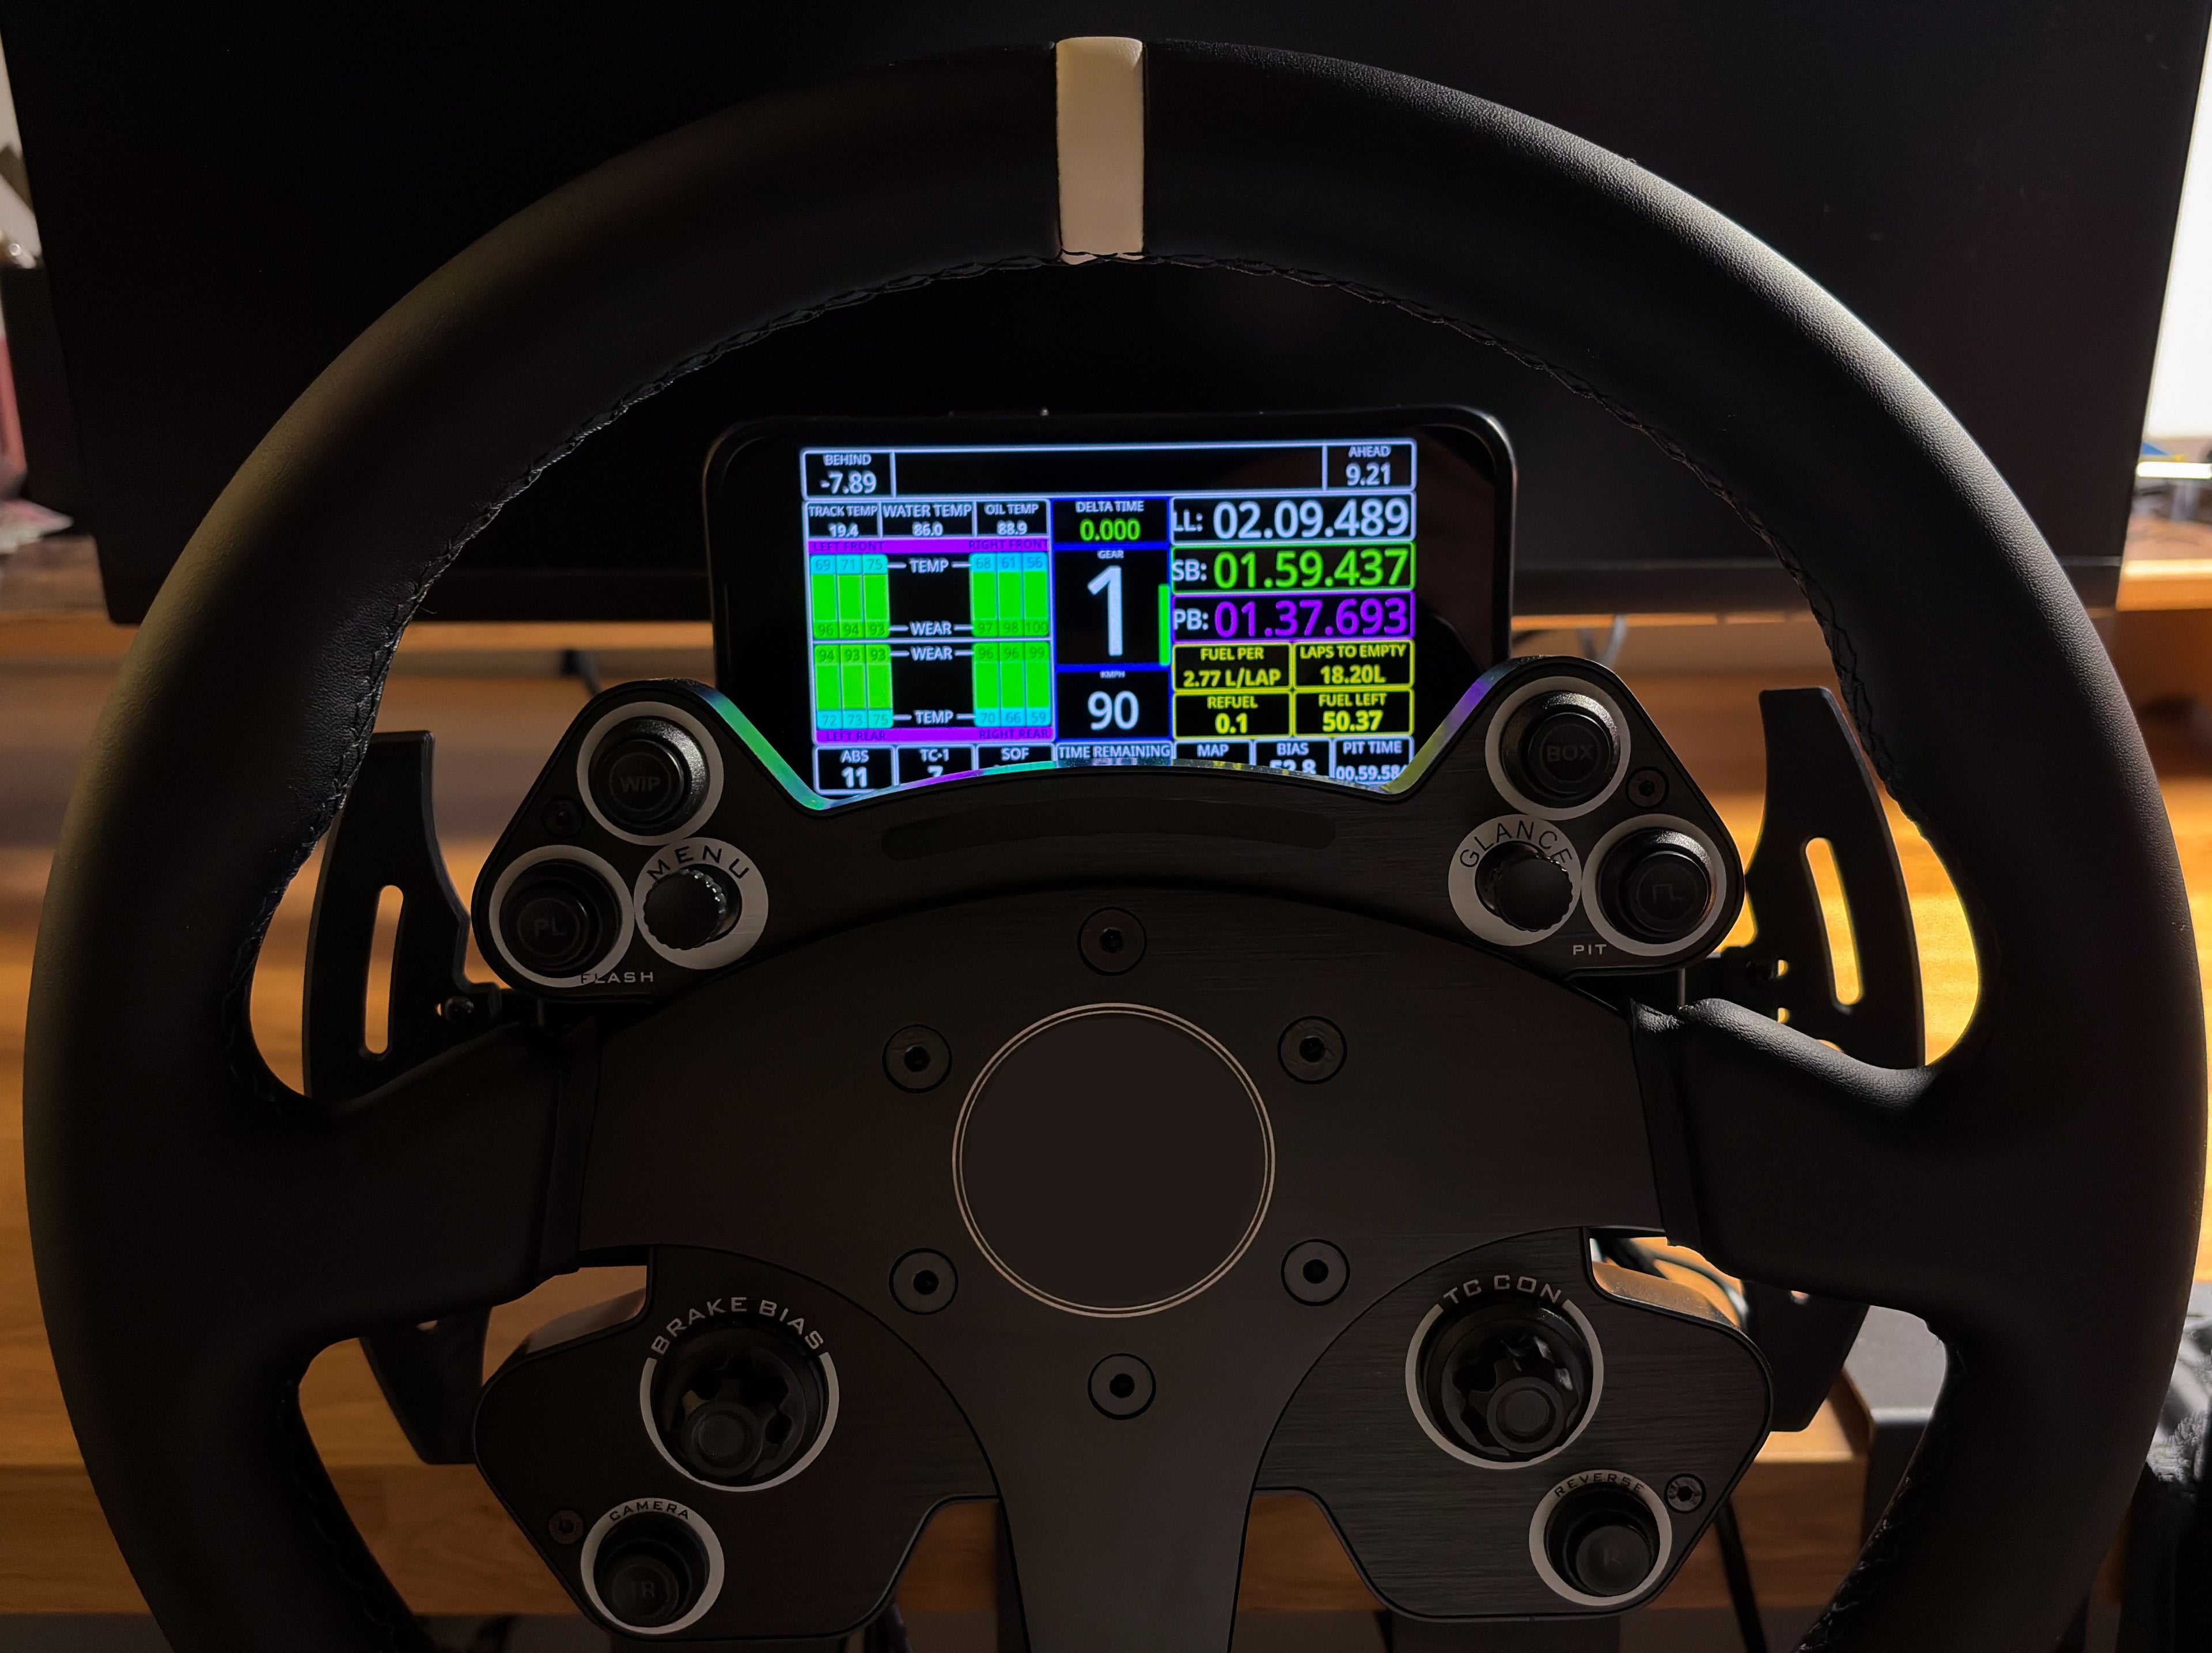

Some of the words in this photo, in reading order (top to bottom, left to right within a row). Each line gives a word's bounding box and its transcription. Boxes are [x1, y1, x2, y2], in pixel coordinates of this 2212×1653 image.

[1349, 445, 1392, 458] AHEAD
[823, 454, 871, 467] BEHIND
[1346, 463, 1391, 486] 9.21
[820, 471, 876, 494] -7.89
[809, 505, 844, 517] TRACK
[847, 505, 877, 516] TEMP
[882, 505, 930, 517] WATER
[934, 504, 972, 516] TEMP
[984, 504, 1005, 515] OIL
[1007, 504, 1039, 515] TEMP
[1075, 501, 1113, 512] DELTA
[1114, 500, 1144, 512] TIME
[1173, 509, 1203, 532] LL:
[1213, 498, 1409, 539] 02.09.489
[828, 524, 859, 538] 19.4
[912, 522, 944, 536] 86.0
[997, 520, 1028, 536] 88.9
[1080, 518, 1141, 541] 0.000
[813, 542, 839, 551] LEFT
[844, 542, 884, 551] FRONT
[969, 540, 1004, 550] RIGHT
[1009, 539, 1048, 549] FRONT
[1097, 550, 1124, 559] GEAR
[816, 558, 831, 571] 69
[841, 558, 855, 570] 71
[867, 558, 883, 570] 75
[908, 558, 949, 574] TEMP
[1002, 557, 1016, 569] 61
[1172, 559, 1207, 581] SB:
[1214, 548, 1409, 588] 01.59.437
[1087, 565, 1123, 656] 1
[1174, 608, 1209, 630] PB:
[1214, 597, 1408, 638] 01.37.693
[910, 621, 952, 636] WEAR
[910, 646, 953, 661] WEAR
[1200, 647, 1234, 661] FUEL
[1238, 646, 1264, 660] PER
[1300, 645, 1335, 659] LAPS
[1338, 645, 1356, 658] TO
[1359, 644, 1406, 658] EMPTY
[1100, 671, 1126, 679] KMPH
[1183, 670, 1221, 687] 2.77
[1225, 667, 1281, 688] L/LAP
[1320, 664, 1387, 684] 18.20L
[1207, 695, 1258, 709] REFUEL
[1319, 694, 1353, 708] FUEL
[1355, 693, 1387, 706] LEFT
[915, 710, 954, 725] TEMP
[1088, 691, 1139, 731] 90
[821, 714, 838, 726] 72
[1214, 713, 1248, 734] 0.1
[1323, 710, 1383, 732] 50.37
[827, 732, 851, 742] LEFT
[979, 729, 1014, 739] RIGHT
[1018, 728, 1048, 739] REAR
[1001, 748, 1029, 761] SOF
[1059, 747, 1090, 758] TIME
[1094, 745, 1171, 758] REMAINING
[1197, 744, 1229, 758] MAP
[1277, 743, 1309, 756] BIAS
[1343, 742, 1365, 755] PIT
[1368, 741, 1403, 754] TIME
[1547, 744, 1594, 762] BOX
[842, 749, 869, 763] ABS
[841, 766, 868, 788] 11
[1460, 819, 1573, 868] GLANCE
[646, 845, 750, 882] MENU
[1573, 944, 1607, 955] PIT
[581, 971, 654, 984] FLASH
[1443, 1278, 1482, 1305] TC
[1493, 1274, 1562, 1304] CON
[650, 1297, 748, 1356] BRAKE
[757, 1299, 824, 1350] BIAS
[1554, 1472, 1645, 1498] REVERSE
[609, 1500, 691, 1523] CAMERA
